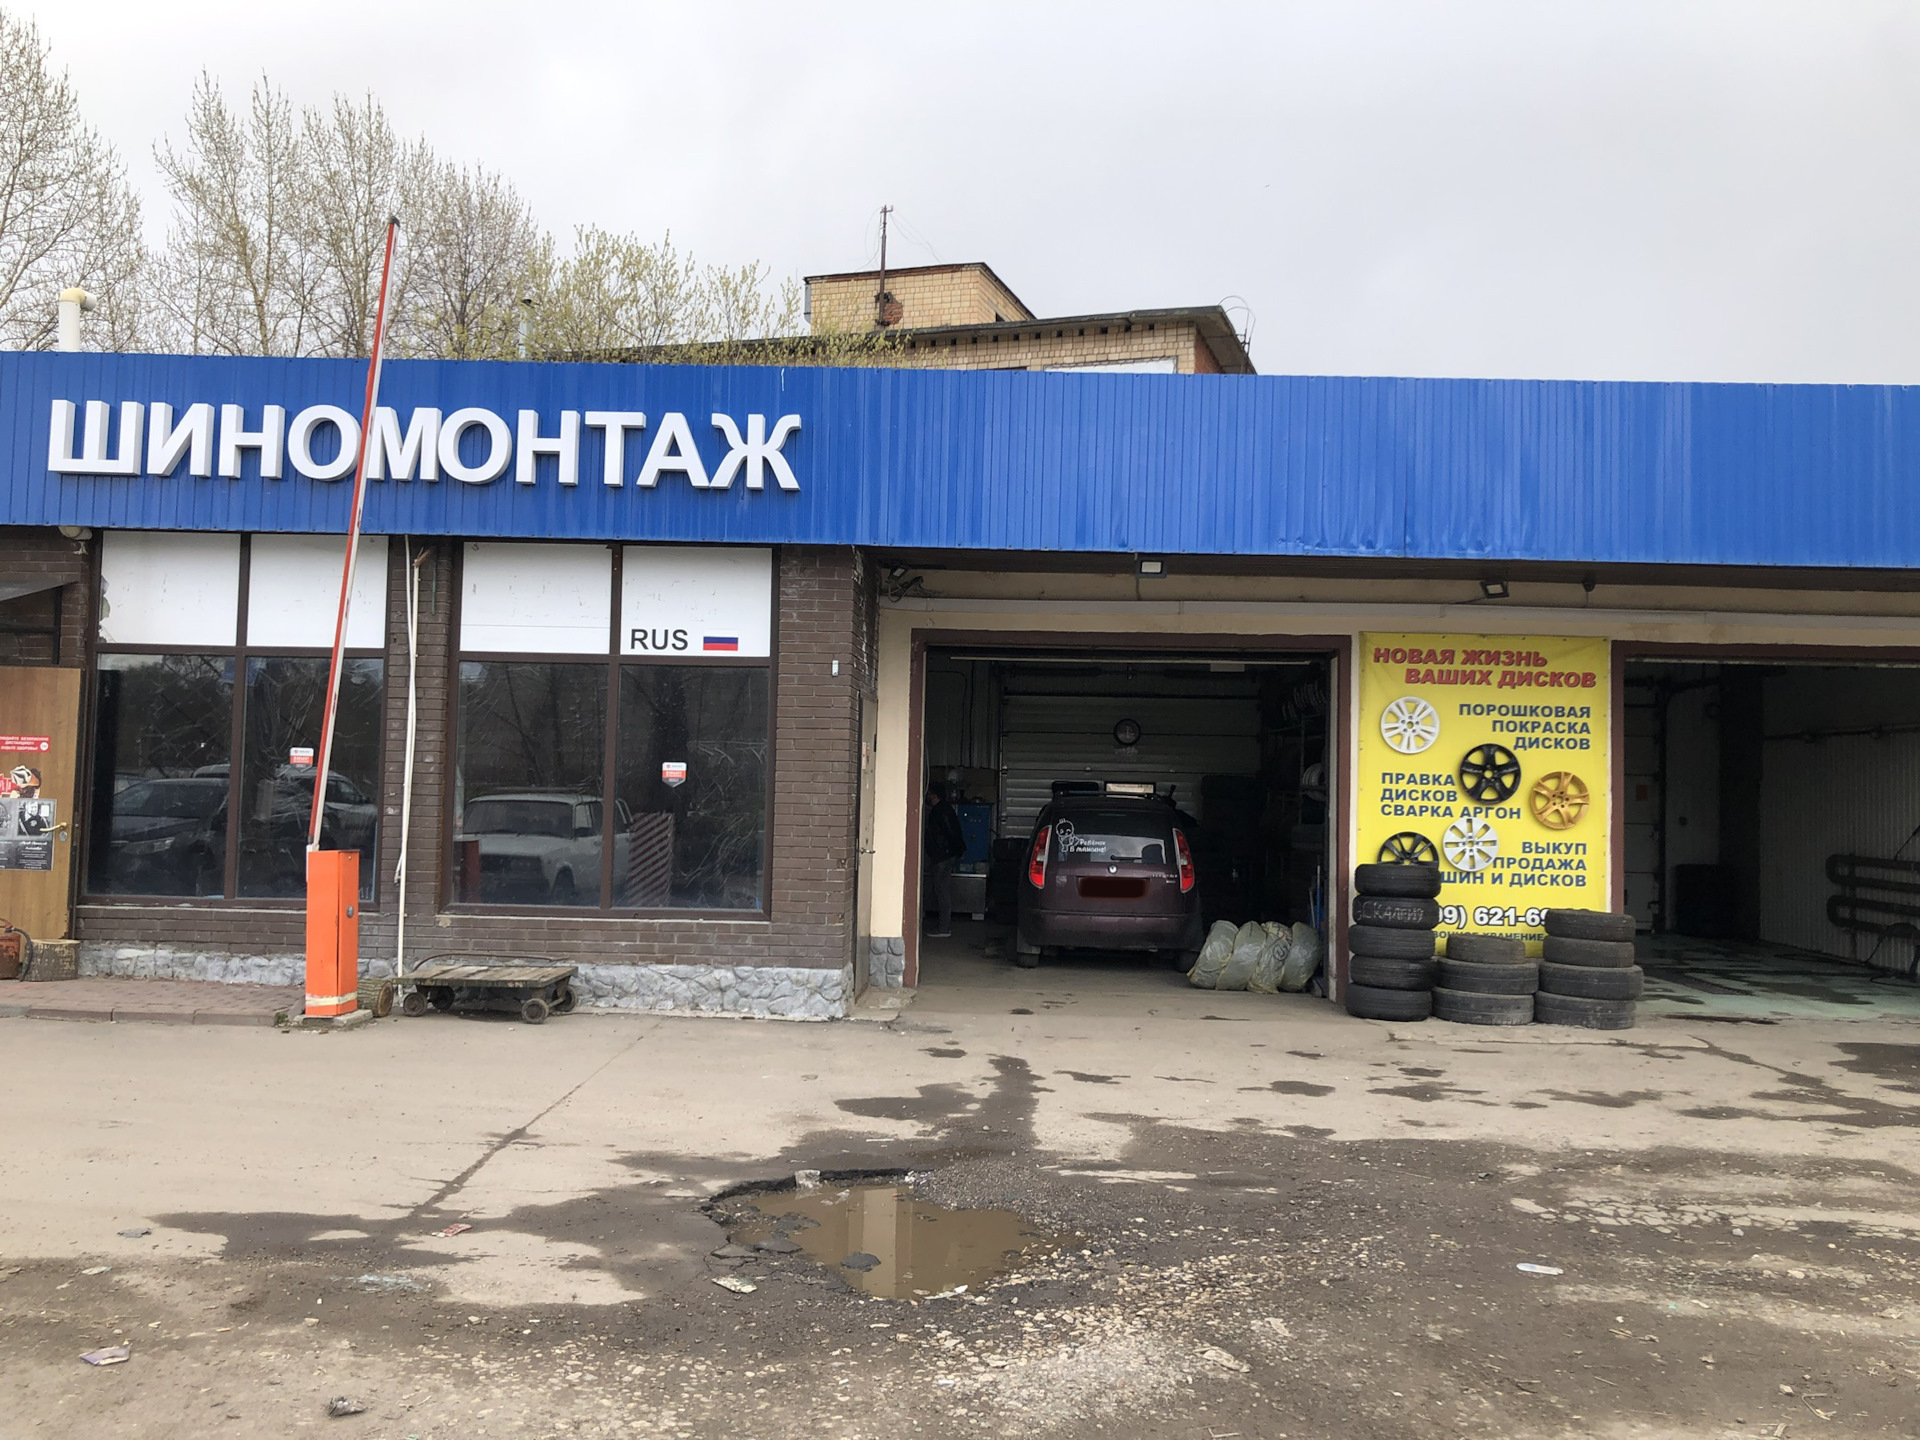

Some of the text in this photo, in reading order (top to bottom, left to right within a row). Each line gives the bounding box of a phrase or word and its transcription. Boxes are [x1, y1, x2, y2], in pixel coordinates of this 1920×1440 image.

[47, 399, 802, 492] ШИНОМОНТАЖ
[630, 628, 689, 651] RUS
[1373, 647, 1547, 667] НОВАЯ ЖИЗНЬ
[1405, 668, 1596, 688] ВАШИХ ДИСКОВ
[1459, 703, 1591, 718] ПОРОШКОВАЯ
[1492, 720, 1591, 734] ПОКРАСКА
[1514, 737, 1590, 750] ДИСКОВ
[1381, 772, 1456, 786] ПРАВКА
[1380, 788, 1457, 803] ДИСКОВ
[1381, 804, 1521, 819] СВАРКА АРГОН
[1522, 842, 1587, 855] ВЫКУП
[1493, 857, 1587, 871] ПРОДАЖА
[1441, 871, 1587, 888] ШИН И ДИСКОВ
